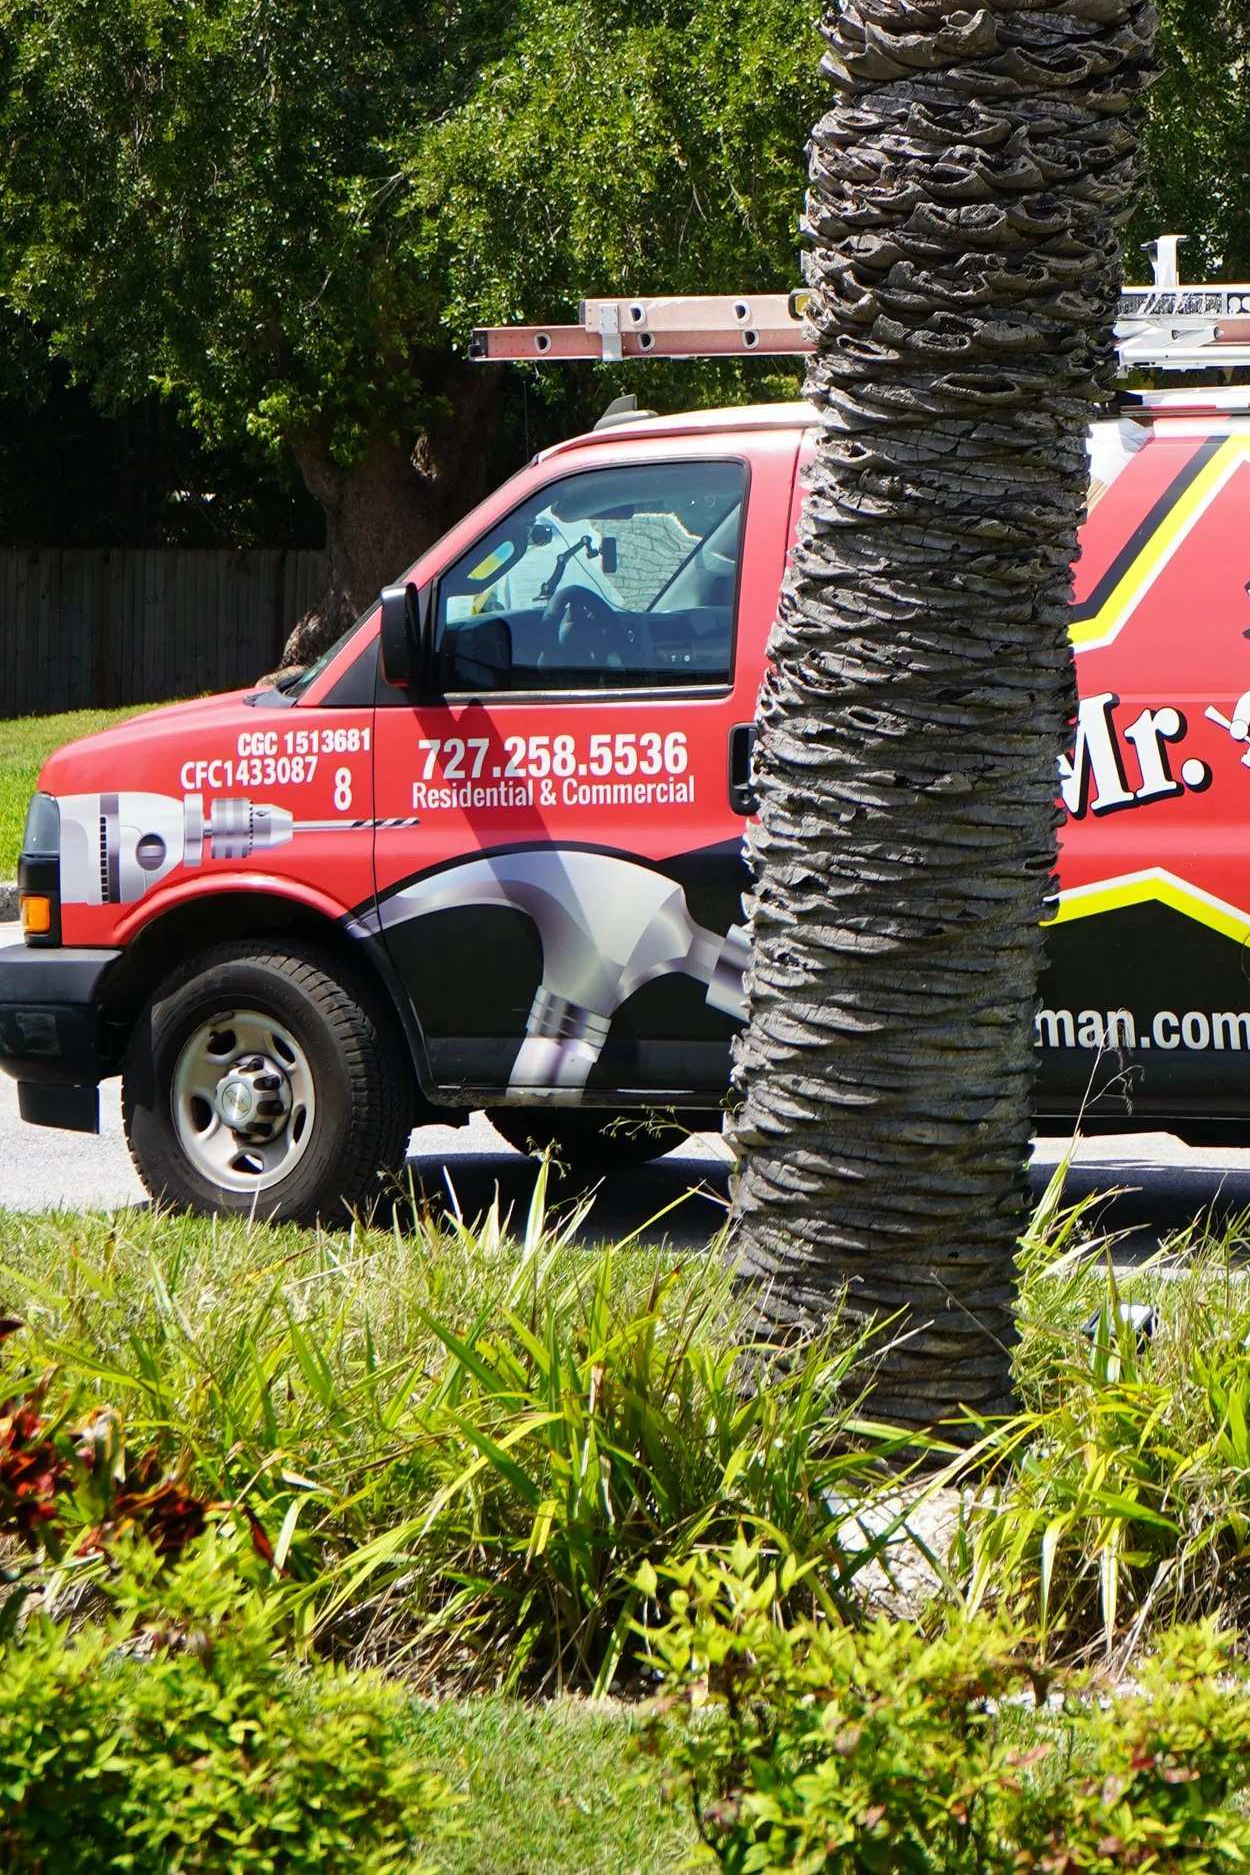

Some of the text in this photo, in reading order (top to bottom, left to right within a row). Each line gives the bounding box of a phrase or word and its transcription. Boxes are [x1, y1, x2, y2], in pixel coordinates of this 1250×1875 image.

[237, 727, 371, 757] CGC 1513681
[418, 731, 689, 780] 727.258.5536
[180, 755, 319, 790] CFC1433087
[334, 767, 352, 811] 8
[412, 775, 696, 809] Residential & Commercial
